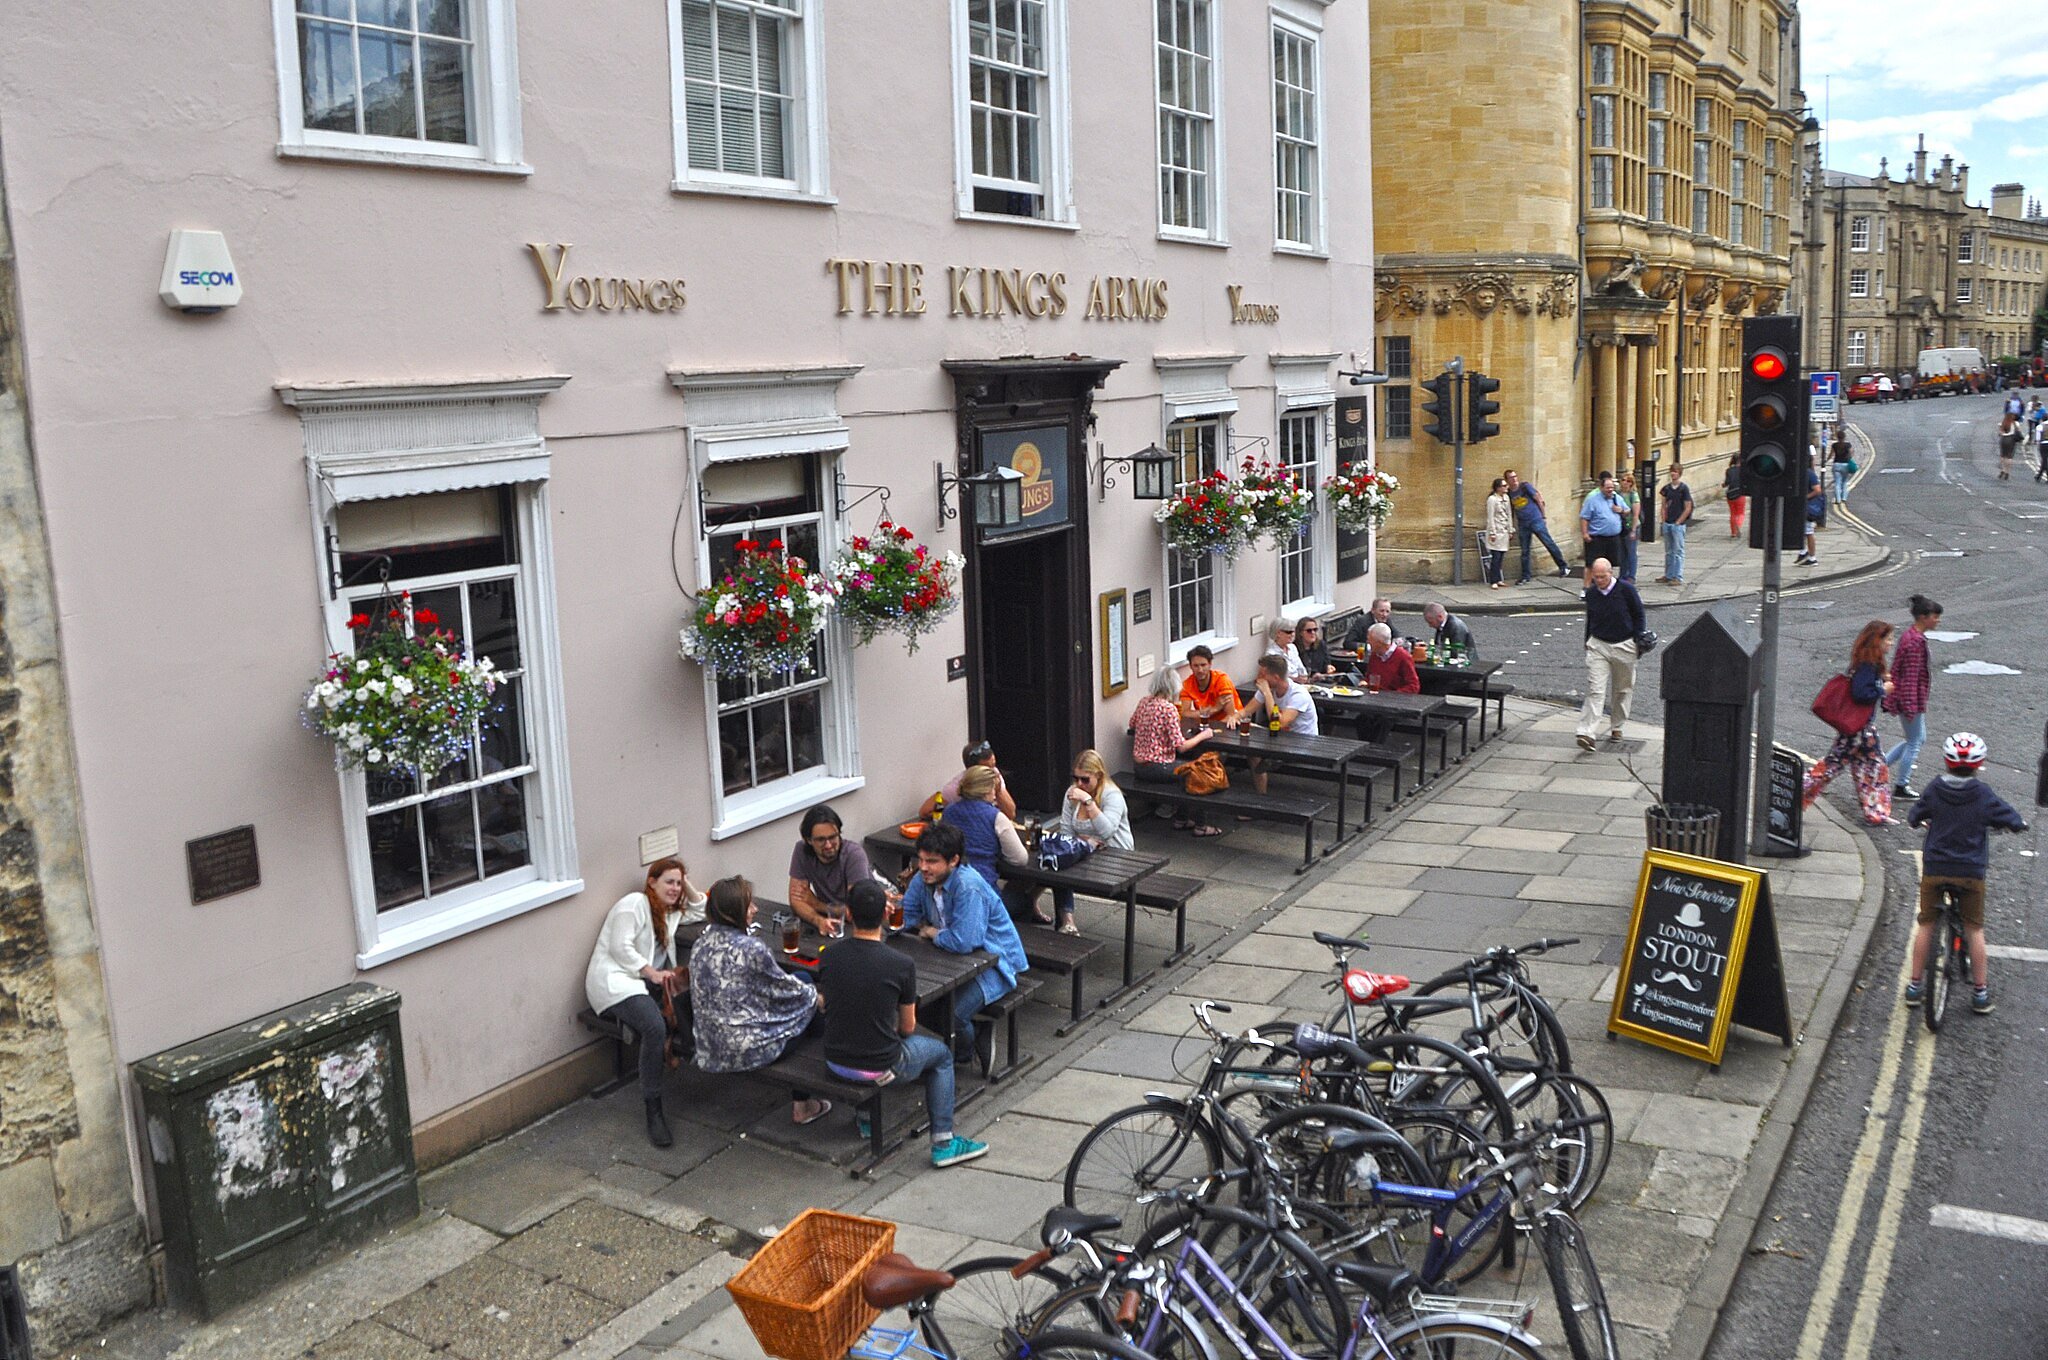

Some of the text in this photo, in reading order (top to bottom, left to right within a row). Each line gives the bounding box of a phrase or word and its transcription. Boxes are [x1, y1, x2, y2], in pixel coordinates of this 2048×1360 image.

[180, 271, 233, 286] SECOM
[826, 258, 1168, 321] THE KINGS ARMS
[1652, 875, 1737, 913] Now Serving
[1658, 923, 1718, 948] LONDON
[1643, 936, 1727, 976] STOUT
[1642, 1003, 1704, 1033] kingsarmsoxford
